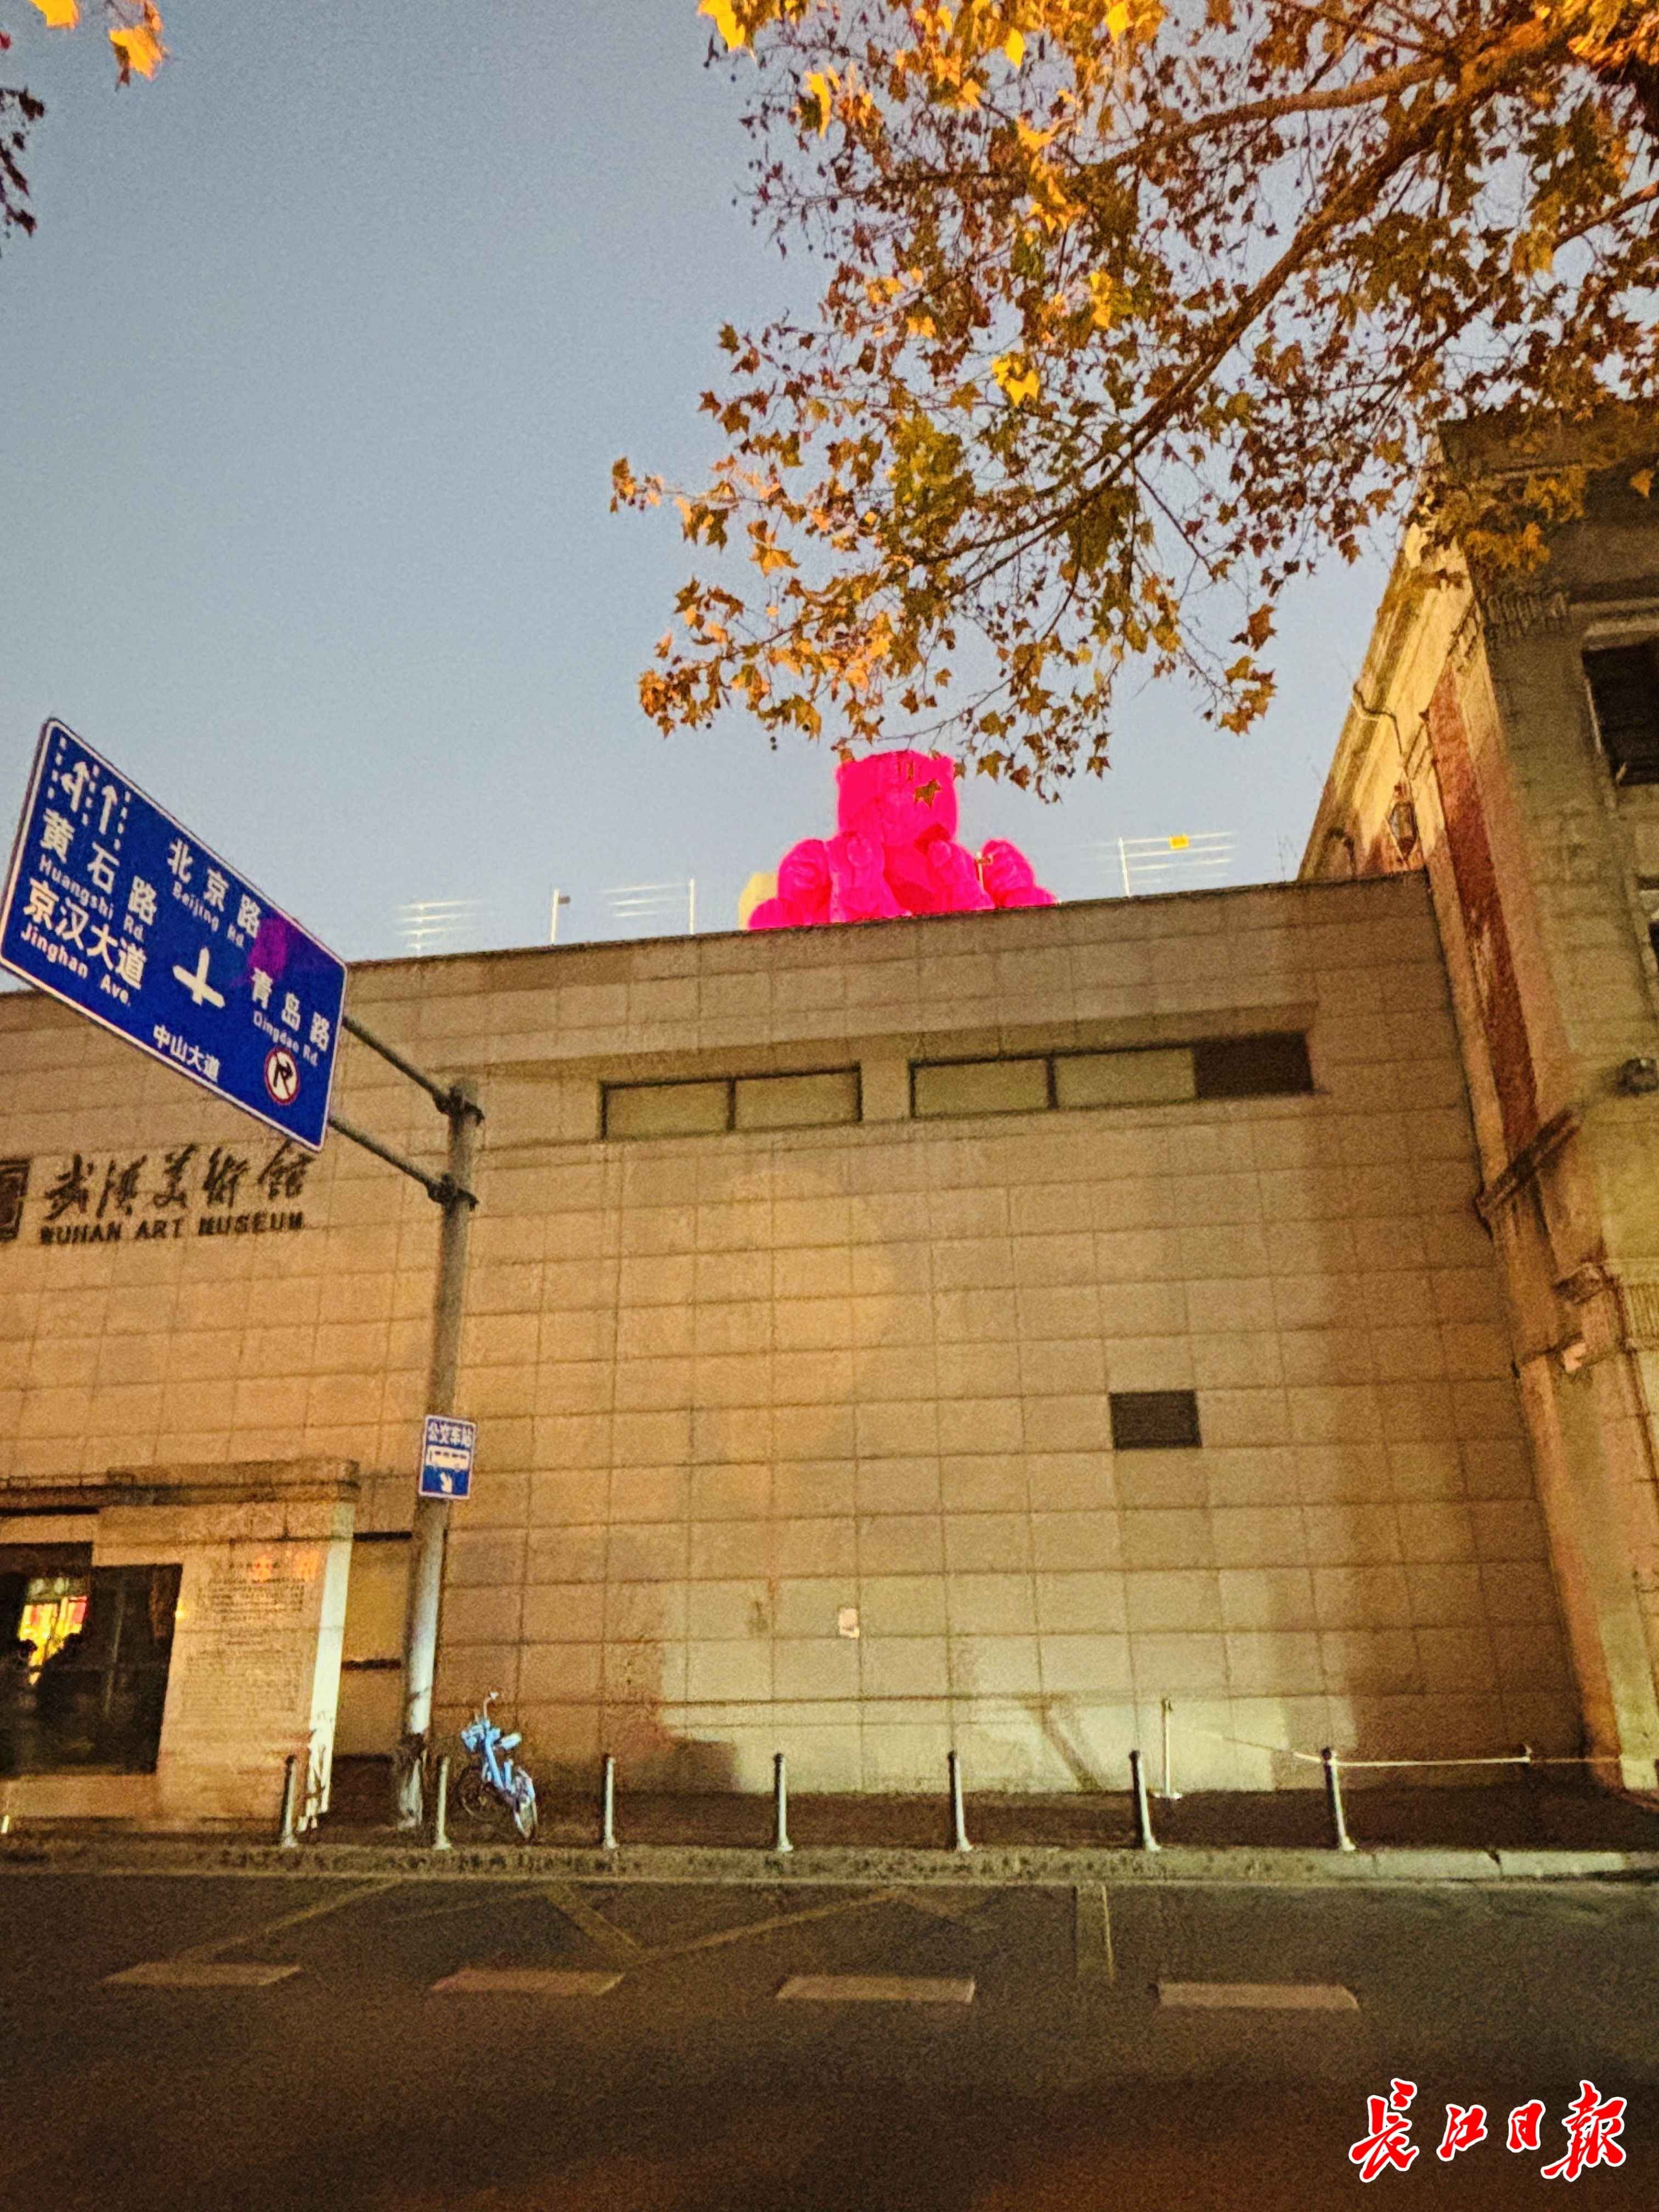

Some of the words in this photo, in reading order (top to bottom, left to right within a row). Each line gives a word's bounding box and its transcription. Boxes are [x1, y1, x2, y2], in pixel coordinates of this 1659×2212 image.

[40, 808, 157, 926] 黄石路
[40, 854, 114, 920] Huangshi
[167, 838, 261, 939] 北京路
[23, 878, 147, 990] 京汉大道
[173, 881, 219, 932] Beijing
[21, 922, 88, 979] Jinghan
[251, 967, 330, 1052] 青岛路
[253, 1010, 300, 1053] Qingdao
[154, 1024, 220, 1082] 中山大道
[40, 1221, 122, 1245] WUHAN
[135, 1218, 182, 1240] ART
[198, 1211, 304, 1237] MUSEUM
